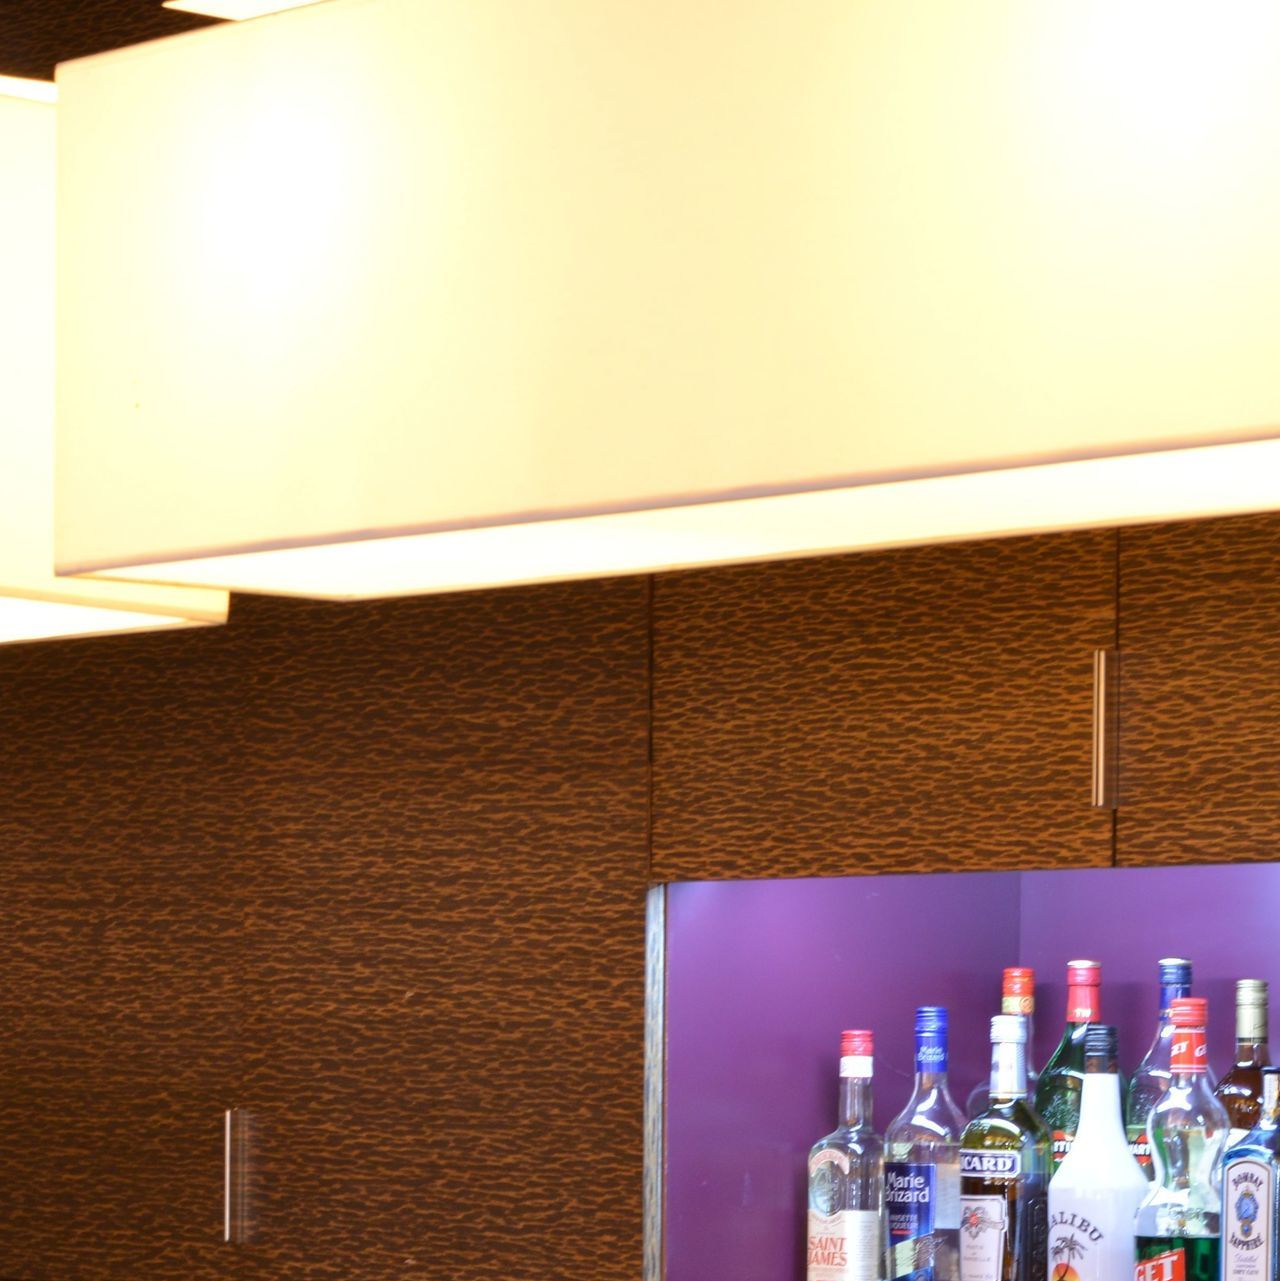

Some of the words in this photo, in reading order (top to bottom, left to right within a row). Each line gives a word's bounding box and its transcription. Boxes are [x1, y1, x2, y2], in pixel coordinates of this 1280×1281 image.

[887, 1171, 925, 1188] Marie
[1232, 1171, 1264, 1191] BOMBAY
[809, 1237, 847, 1250] SAINT
[1229, 1233, 1264, 1250] SAPPHIRE
[808, 1252, 848, 1267] JAMES
